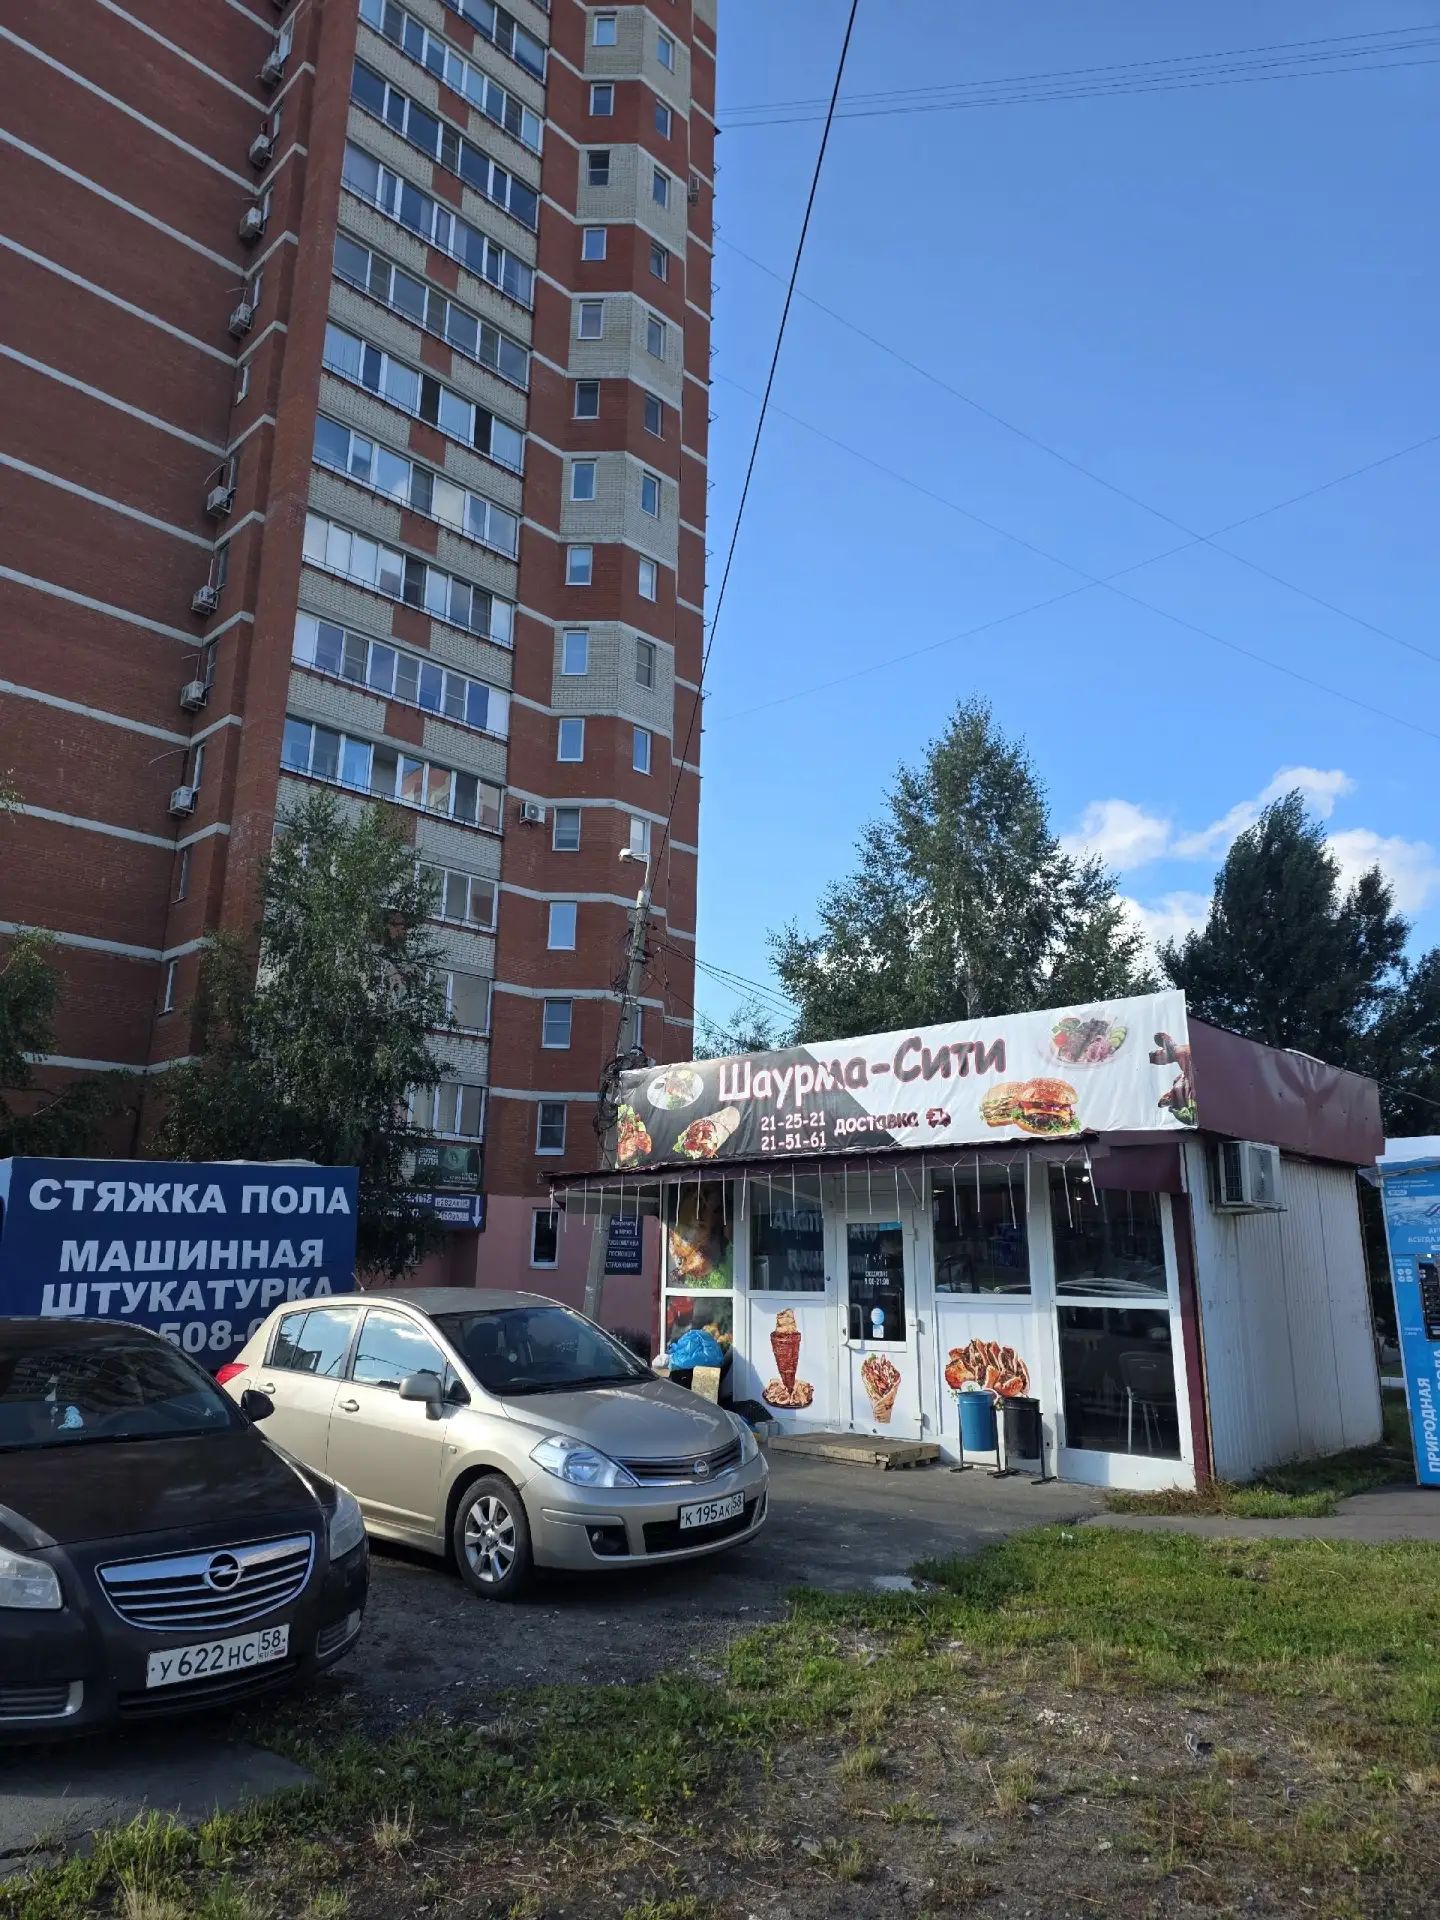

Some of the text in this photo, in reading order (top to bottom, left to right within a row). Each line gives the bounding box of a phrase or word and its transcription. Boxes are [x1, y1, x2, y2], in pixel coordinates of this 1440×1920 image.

[718, 1035, 1007, 1109] Шаурма-Сити
[760, 1111, 826, 1132] 21-25-21
[834, 1111, 919, 1136] доставка
[761, 1131, 827, 1152] 21-51-61
[29, 1178, 351, 1214] СТЯЖКА ПОЛА
[59, 1239, 324, 1272] МАШИННАЯ
[40, 1276, 333, 1317] ШТУКАТУРКА
[1417, 1377, 1440, 1473] ПРИРОДНАЯ
[261, 1629, 281, 1651] 58
